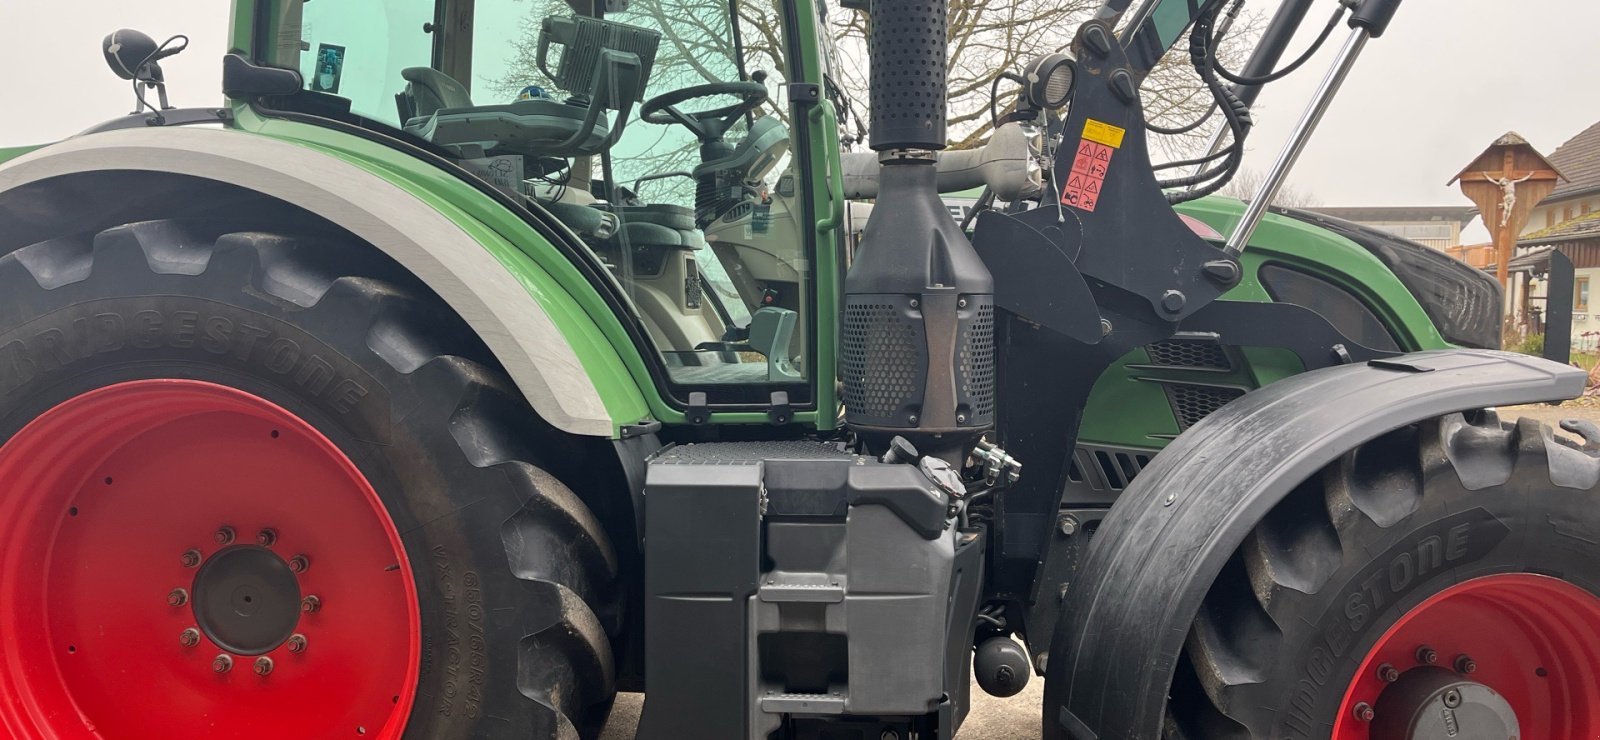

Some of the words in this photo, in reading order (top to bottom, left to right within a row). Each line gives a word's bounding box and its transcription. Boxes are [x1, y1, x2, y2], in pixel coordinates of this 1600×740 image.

[0, 309, 368, 414] BRIDGESTONE
[432, 543, 462, 718] VX-TRACTOR
[463, 570, 488, 720] 650/65R42
[1284, 521, 1472, 740] IDGESTONE
